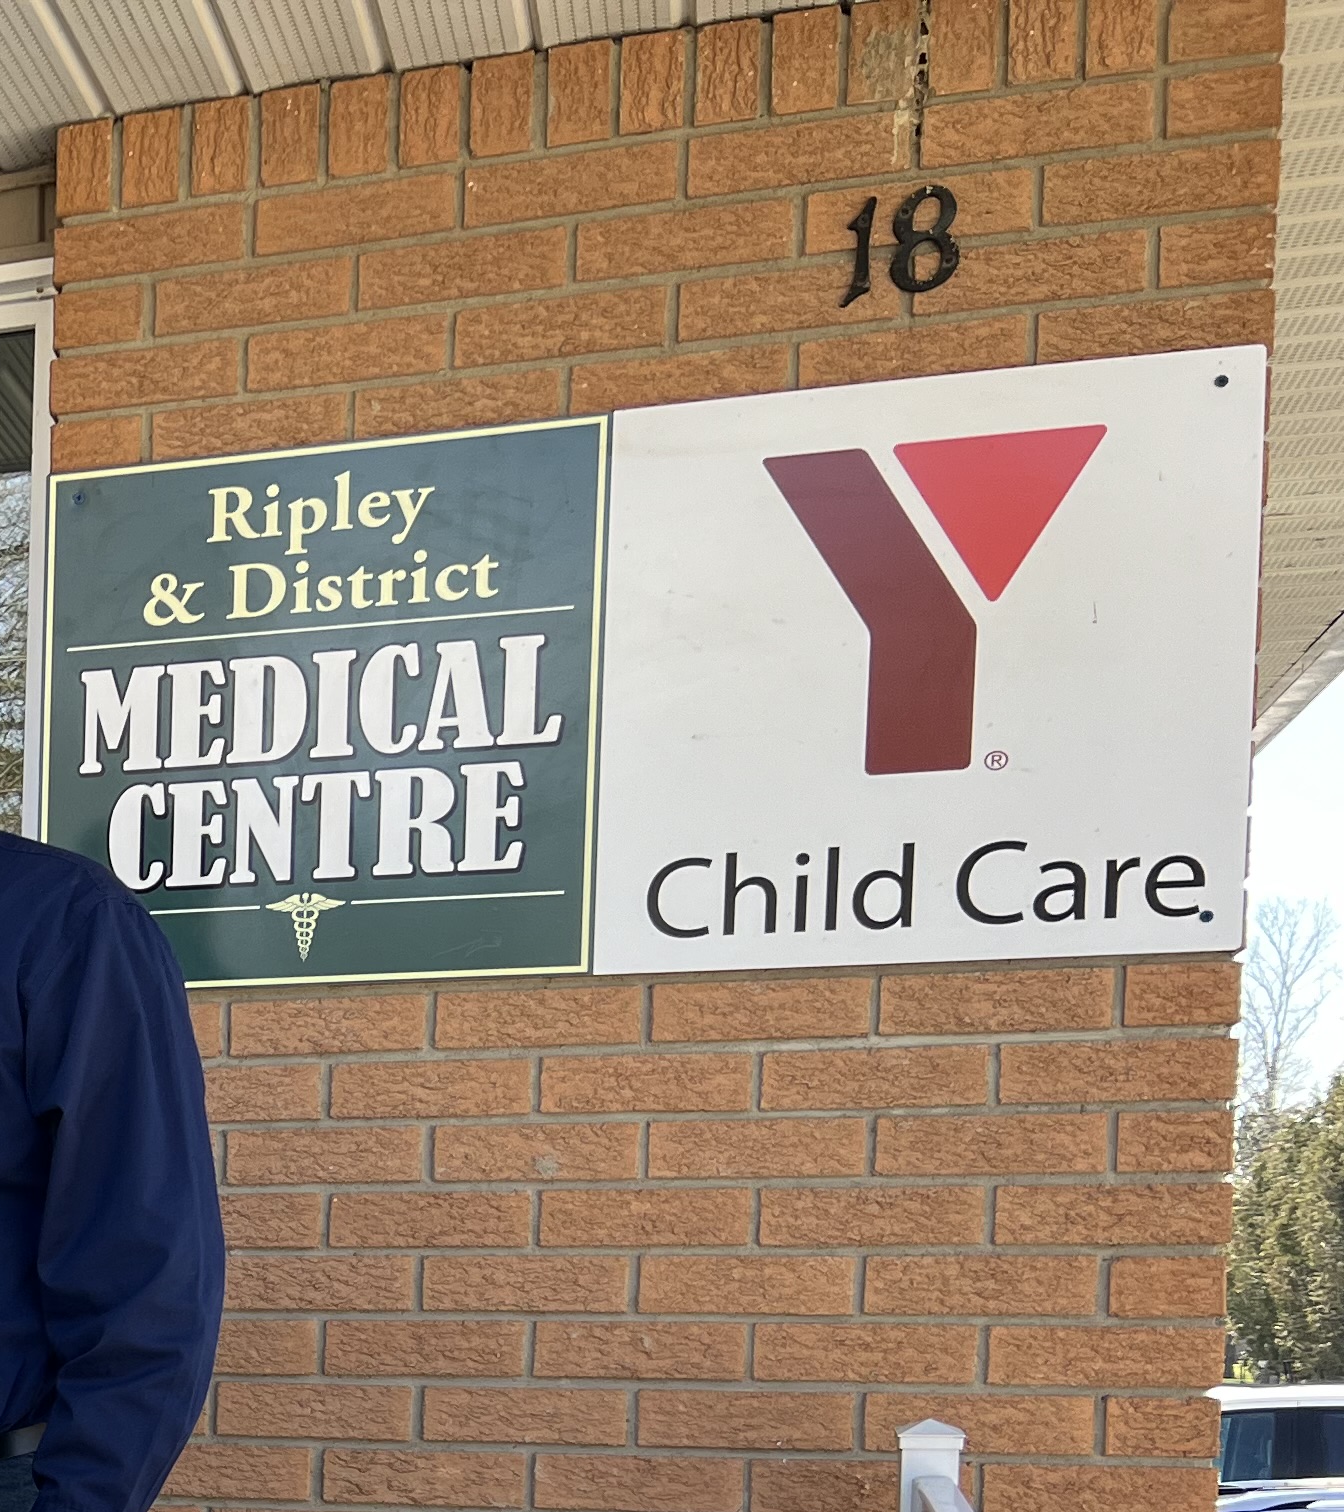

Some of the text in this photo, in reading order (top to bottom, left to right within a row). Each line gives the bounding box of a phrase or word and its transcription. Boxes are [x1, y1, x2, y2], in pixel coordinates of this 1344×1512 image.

[838, 184, 959, 308] 18
[206, 470, 436, 556] Ripley
[143, 549, 500, 627] & District
[78, 633, 565, 776] MEDICAL
[108, 760, 525, 892] CENTRE
[646, 839, 1207, 939] Child Care
